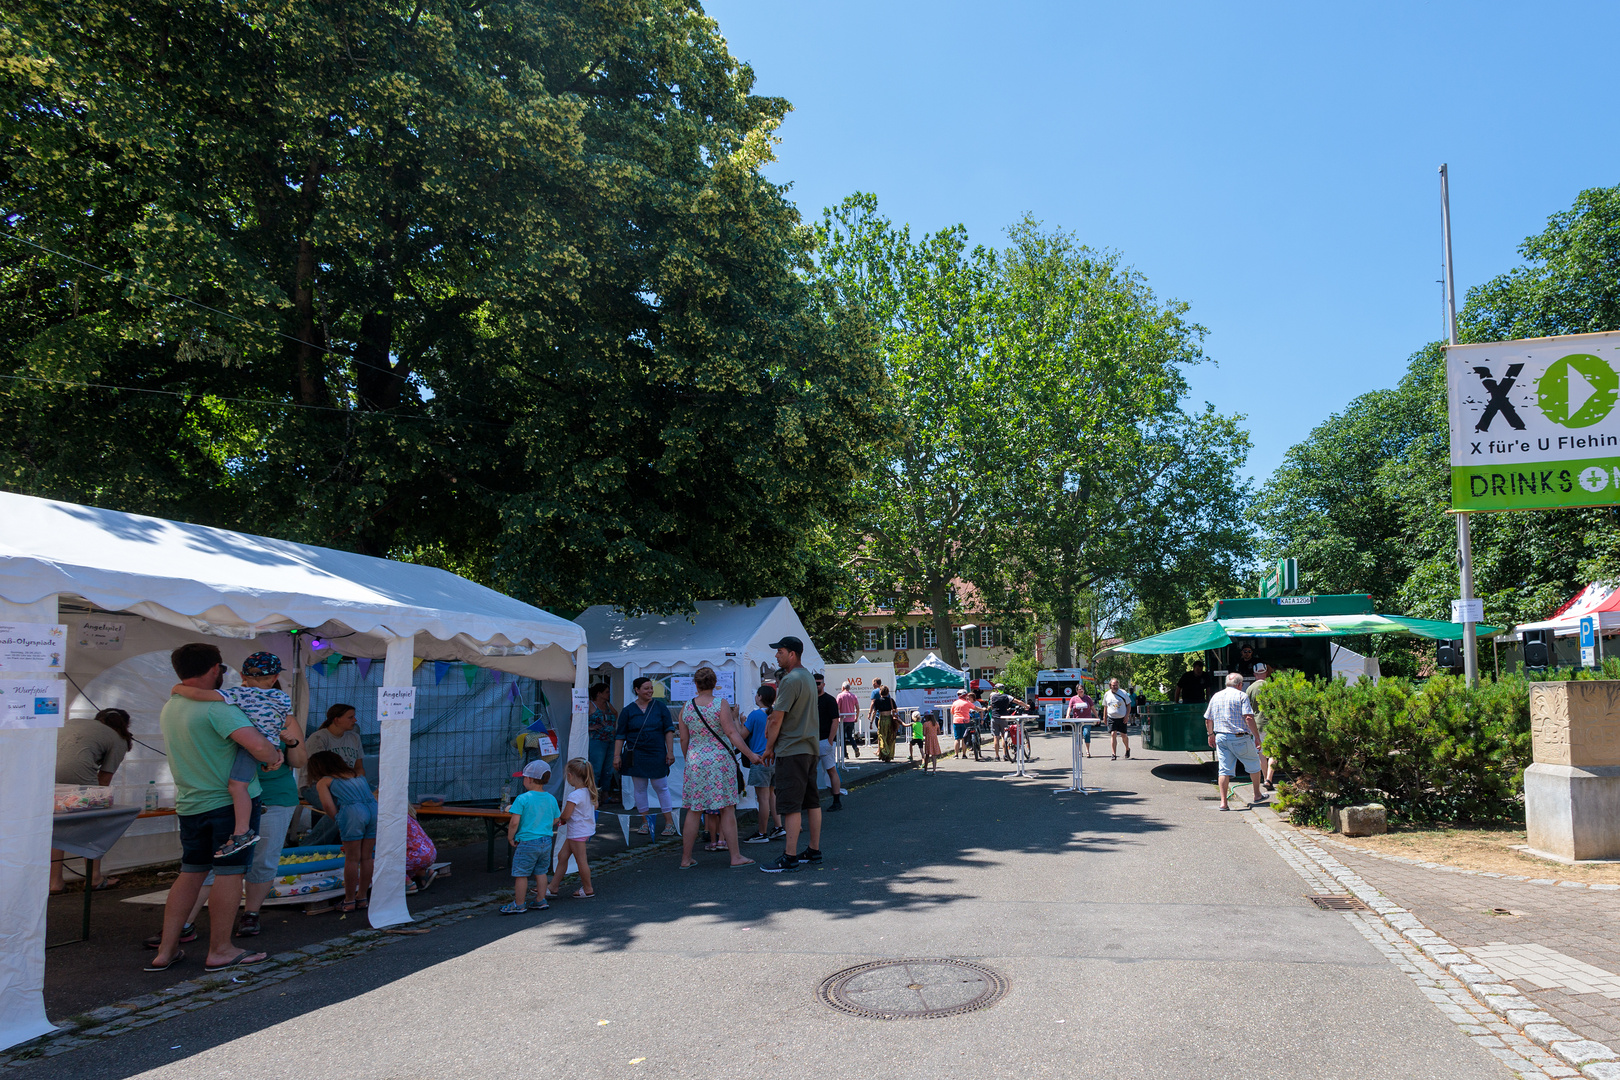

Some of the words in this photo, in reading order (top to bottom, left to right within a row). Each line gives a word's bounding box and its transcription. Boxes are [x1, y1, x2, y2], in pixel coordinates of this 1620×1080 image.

[1472, 363, 1527, 433] X
[1470, 442, 1482, 455] X
[1489, 440, 1530, 454] für'e
[1538, 438, 1550, 451] U
[1558, 434, 1620, 449] Flehin
[1470, 469, 1573, 498] DRINKS
[83, 622, 122, 632] Angelspiel
[1582, 621, 1591, 644] P
[0, 637, 56, 646] aß-Olympiade
[12, 686, 49, 697] Wurfspiel
[382, 690, 413, 699] Angelspiel
